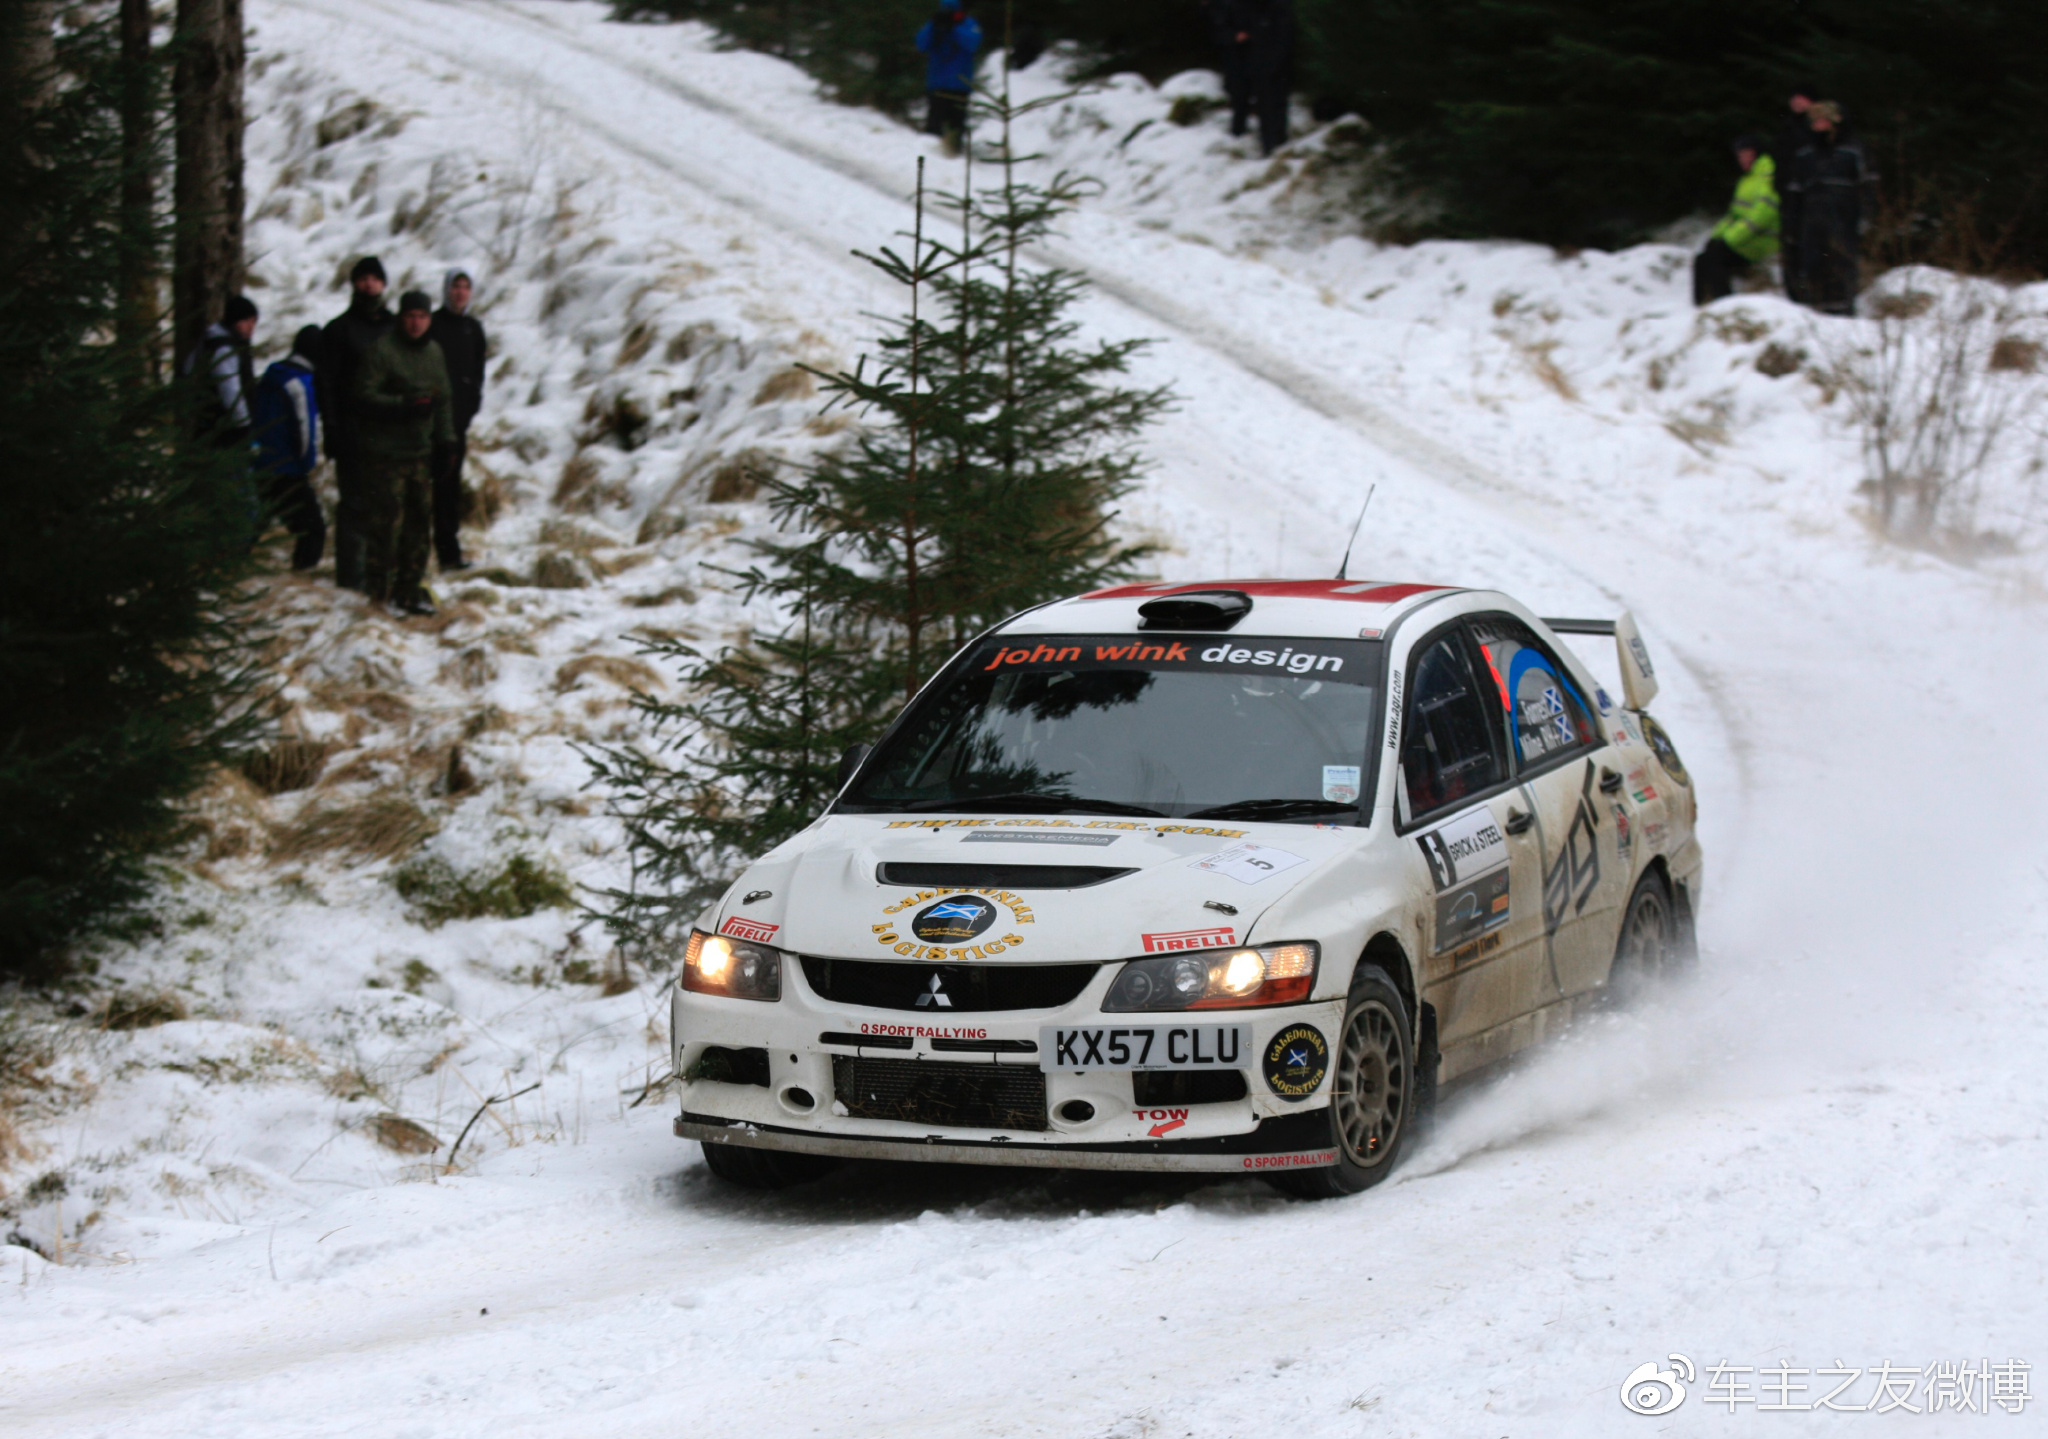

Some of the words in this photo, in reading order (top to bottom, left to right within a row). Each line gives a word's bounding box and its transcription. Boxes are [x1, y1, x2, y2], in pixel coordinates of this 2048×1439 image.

[985, 643, 1080, 671] john
[1095, 642, 1191, 662] wink
[1200, 643, 1344, 674] design
[1387, 669, 1402, 750] www.agr.com
[1423, 825, 1450, 888] 5
[1449, 836, 1476, 862] BRICK
[1476, 825, 1503, 850] STEEL
[1245, 857, 1275, 871] 5
[720, 915, 780, 943] PIRELLI
[871, 922, 1025, 961] LOGISTICS
[1140, 926, 1237, 953] PIRELLI
[861, 1023, 869, 1034] Q
[871, 1024, 914, 1037] SPORT
[916, 1027, 988, 1038] RALLYING
[1270, 1029, 1325, 1062] CALEDONIAN
[1056, 1029, 1155, 1066] KX57
[1168, 1028, 1239, 1065] CLU
[1270, 1068, 1325, 1095] LOGISTICS
[1132, 1108, 1189, 1121] TOW
[1243, 1157, 1253, 1168] Q
[1255, 1155, 1292, 1168] SPORT
[1293, 1151, 1338, 1165] RALLYIN
